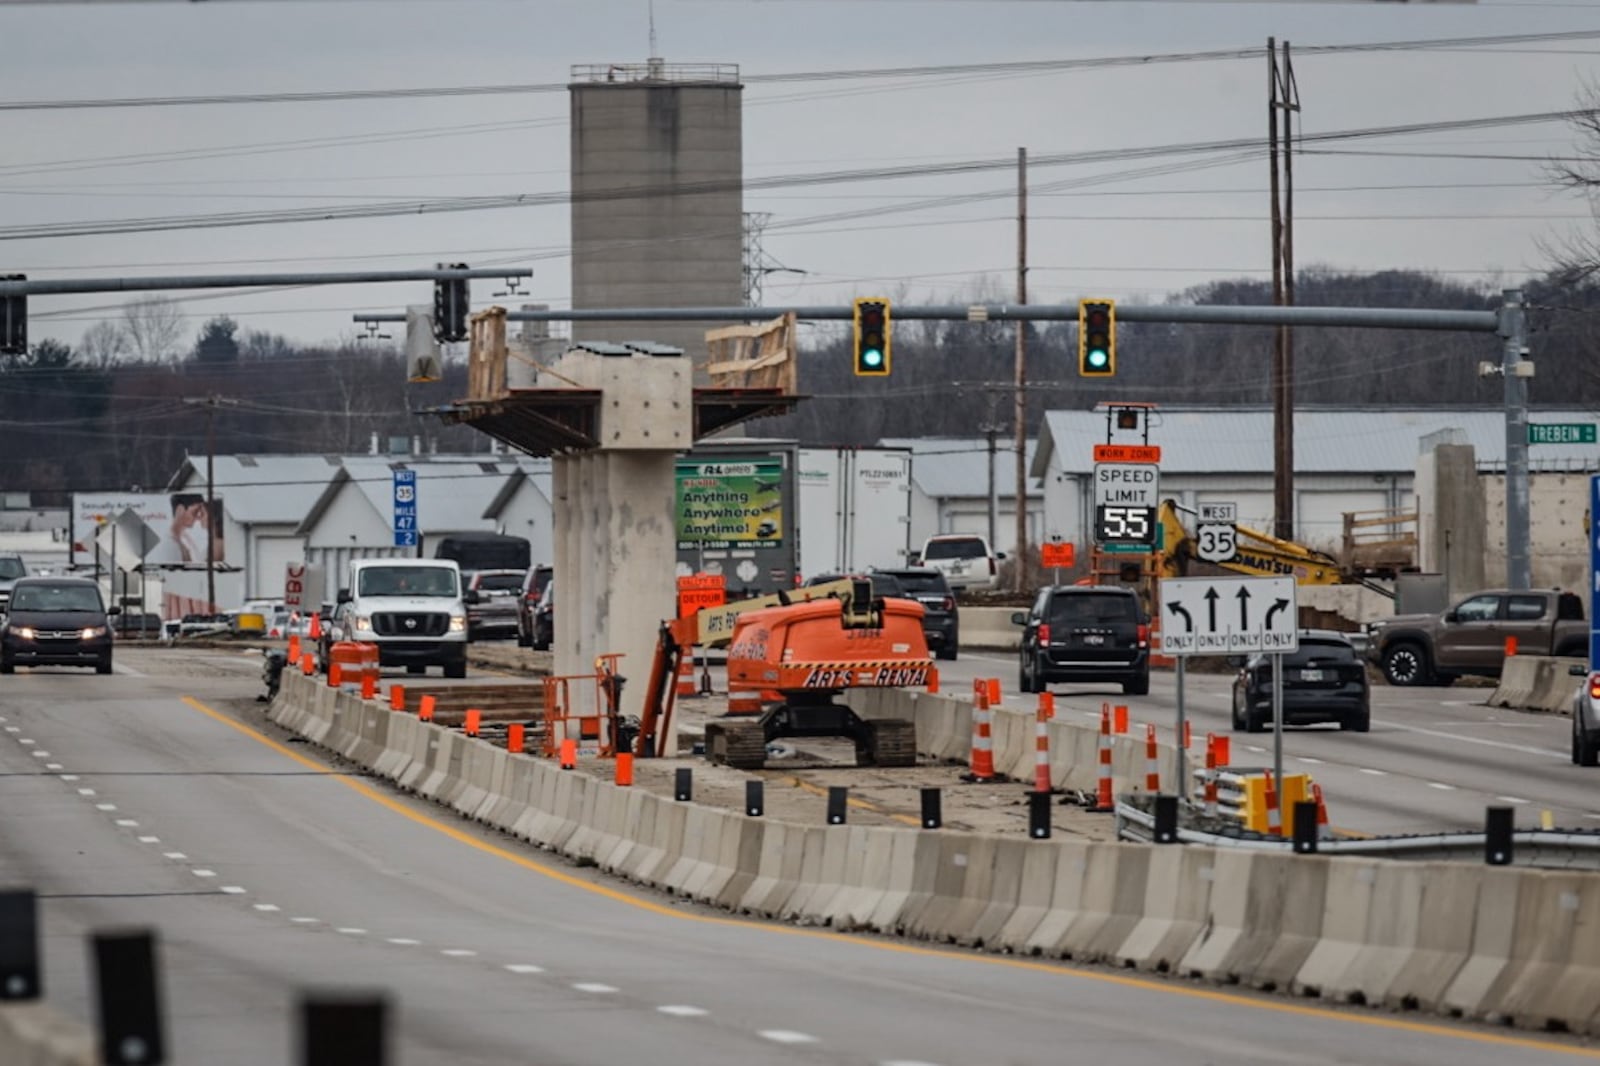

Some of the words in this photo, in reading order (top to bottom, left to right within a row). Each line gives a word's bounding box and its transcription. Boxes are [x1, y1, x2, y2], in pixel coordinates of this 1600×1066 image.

[1532, 426, 1580, 442] TREBEIN
[1099, 450, 1124, 458] WORK
[1130, 451, 1153, 459] ZONE
[396, 473, 413, 481] WEST
[1100, 469, 1153, 483] SPEED
[399, 488, 411, 499] 35
[683, 492, 748, 503] Anything
[1105, 490, 1147, 502] LIMIT
[683, 508, 760, 519] Anywhere
[1202, 506, 1231, 518] WEST
[399, 518, 412, 528] 47
[1104, 508, 1148, 537] 55
[683, 524, 749, 535] Anytime!
[1201, 532, 1231, 553] 35
[683, 593, 721, 604] DETOUR
[1166, 635, 1193, 648] ONLY
[1200, 635, 1226, 647] ONLY
[1231, 634, 1258, 646] ONLY
[1264, 633, 1292, 646] ONLY
[804, 670, 853, 687] ART'S
[875, 668, 930, 686] RENTAL
